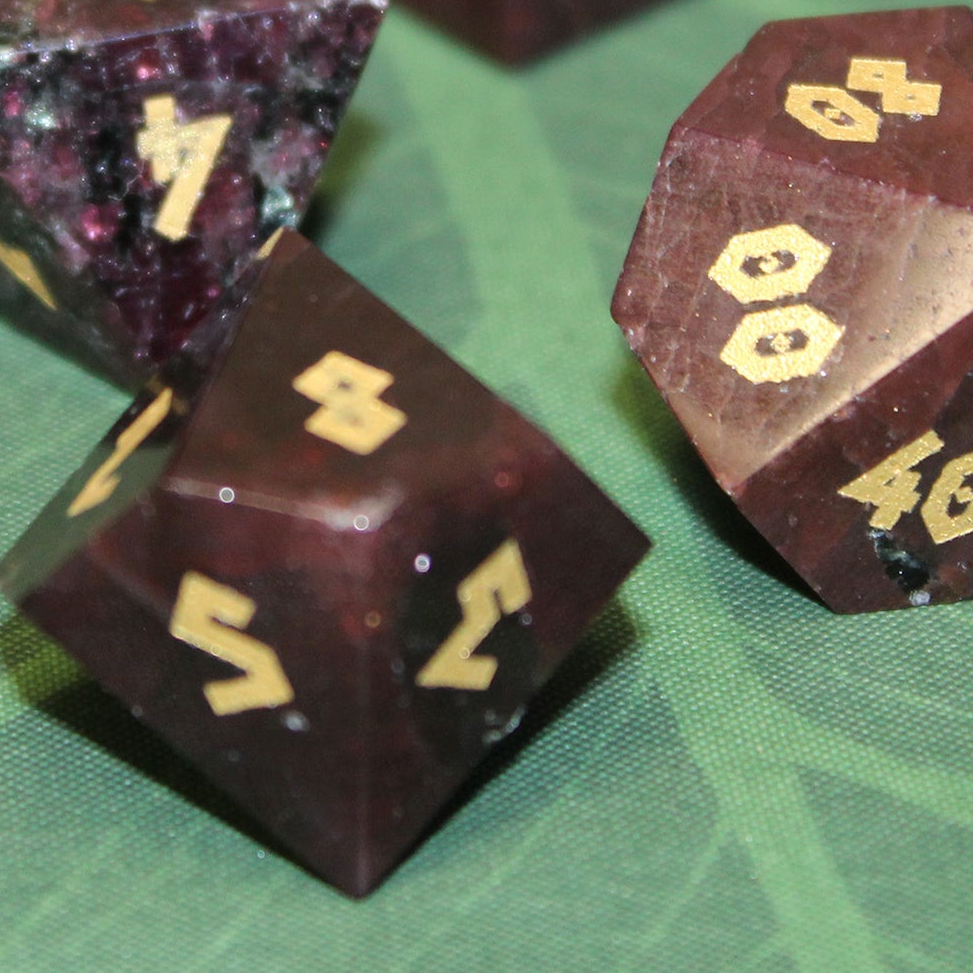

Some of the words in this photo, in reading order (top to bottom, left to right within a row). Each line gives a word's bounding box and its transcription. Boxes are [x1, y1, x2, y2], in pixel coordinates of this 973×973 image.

[137, 95, 233, 240] 4
[707, 222, 845, 385] 00
[293, 351, 407, 454] 8
[171, 573, 293, 715] 5
